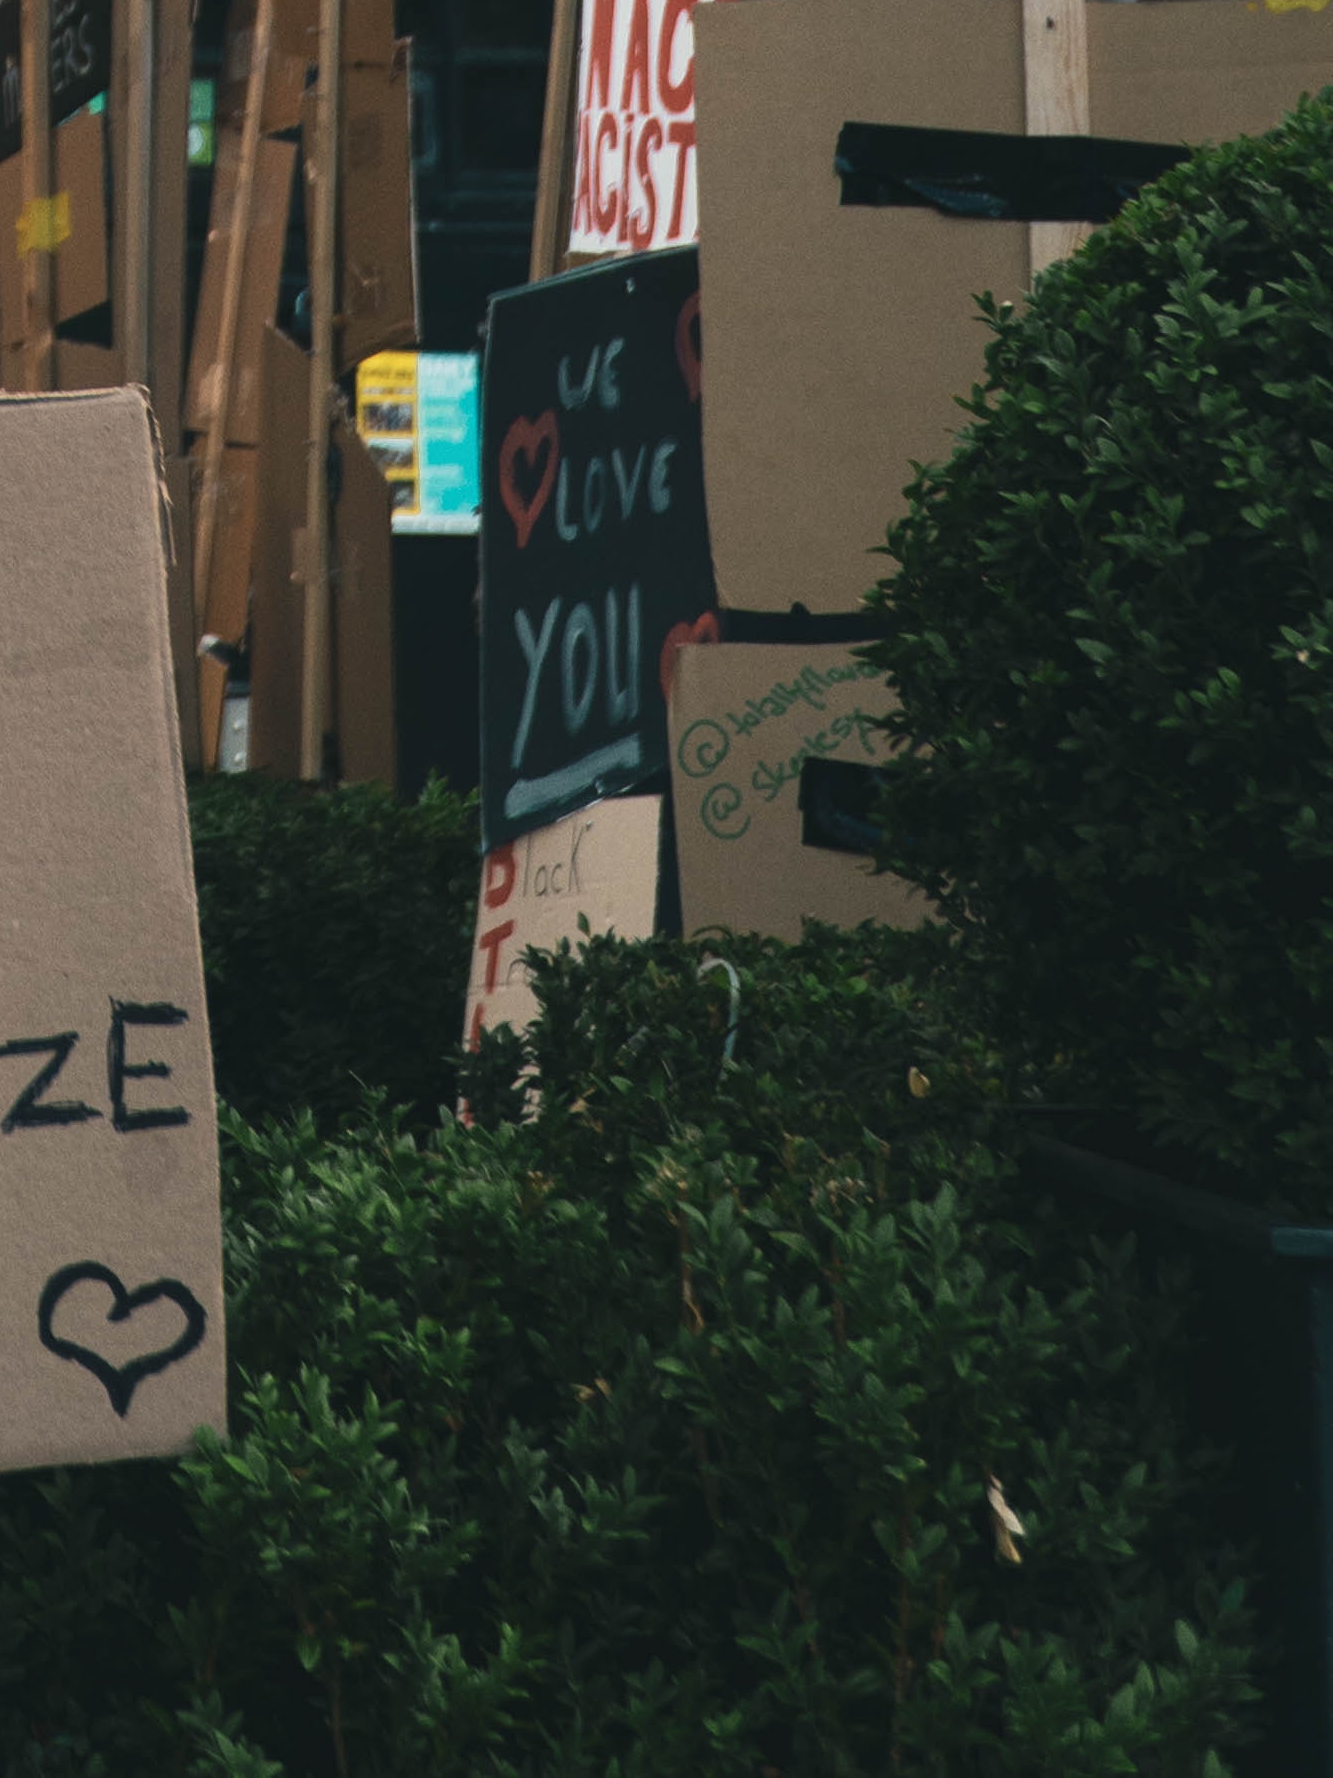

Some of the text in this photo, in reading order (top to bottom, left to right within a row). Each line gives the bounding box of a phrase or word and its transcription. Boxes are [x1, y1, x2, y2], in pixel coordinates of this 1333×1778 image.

[557, 337, 624, 410] WE
[555, 436, 679, 541] LOVE
[511, 582, 639, 769] YOU
